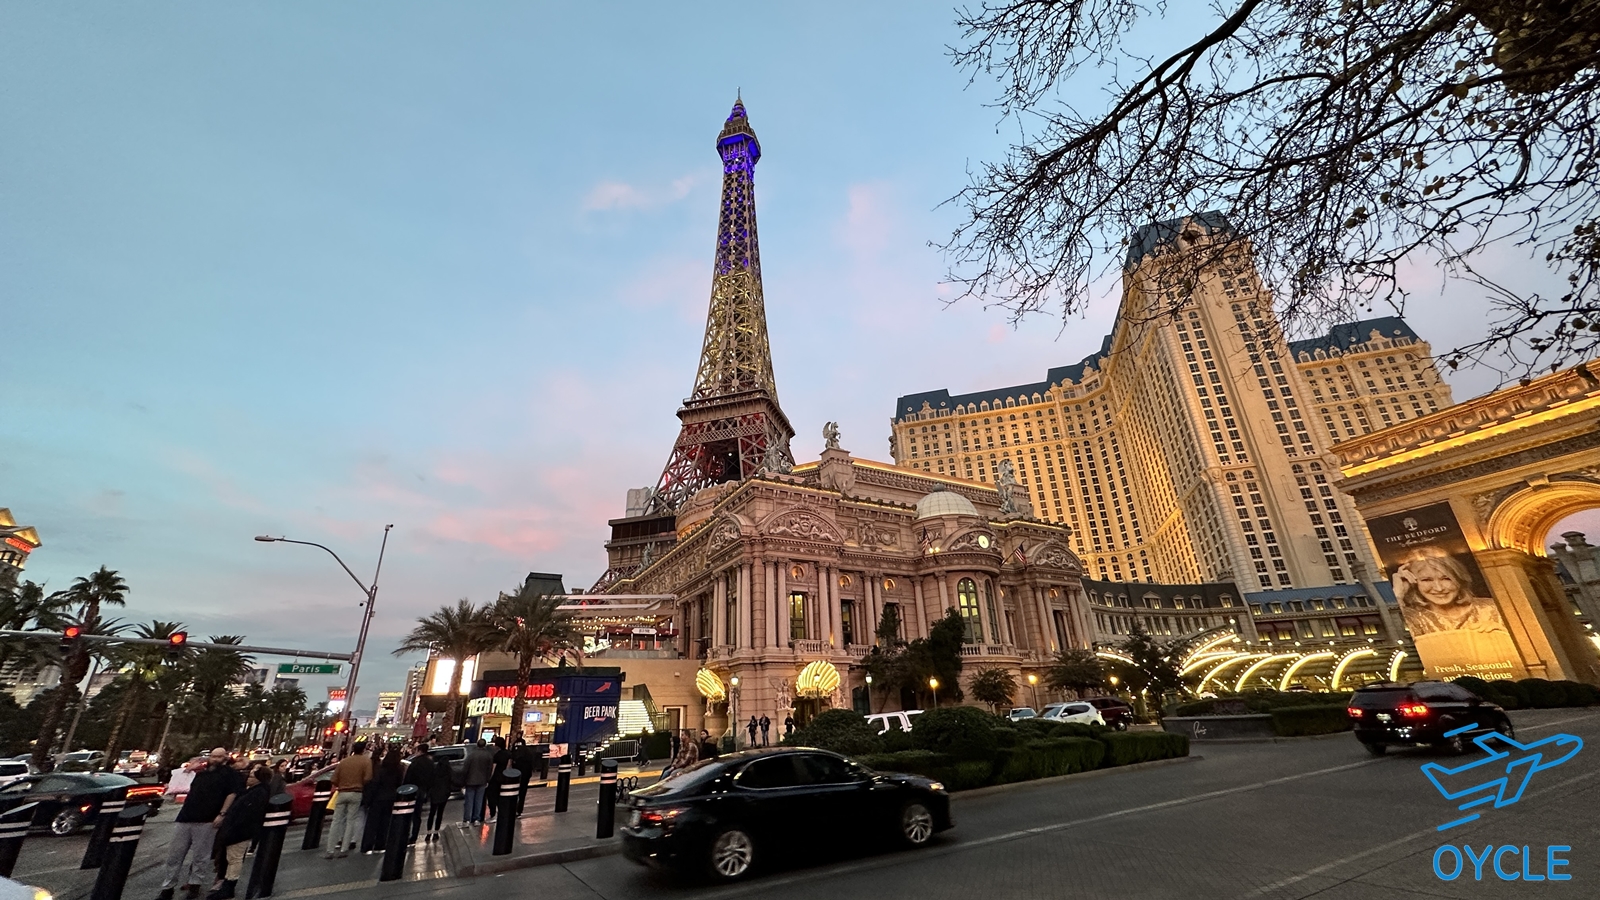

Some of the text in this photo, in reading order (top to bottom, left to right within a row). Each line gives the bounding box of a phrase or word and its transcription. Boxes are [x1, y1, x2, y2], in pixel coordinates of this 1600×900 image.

[1385, 535, 1402, 543] THE
[1404, 525, 1447, 540] BEDFORD
[291, 664, 320, 674] Paris
[1433, 659, 1514, 674] Fresh, Seasonal
[467, 697, 515, 717] BEER PARK
[584, 706, 601, 720] BEER
[600, 705, 617, 719] PARK
